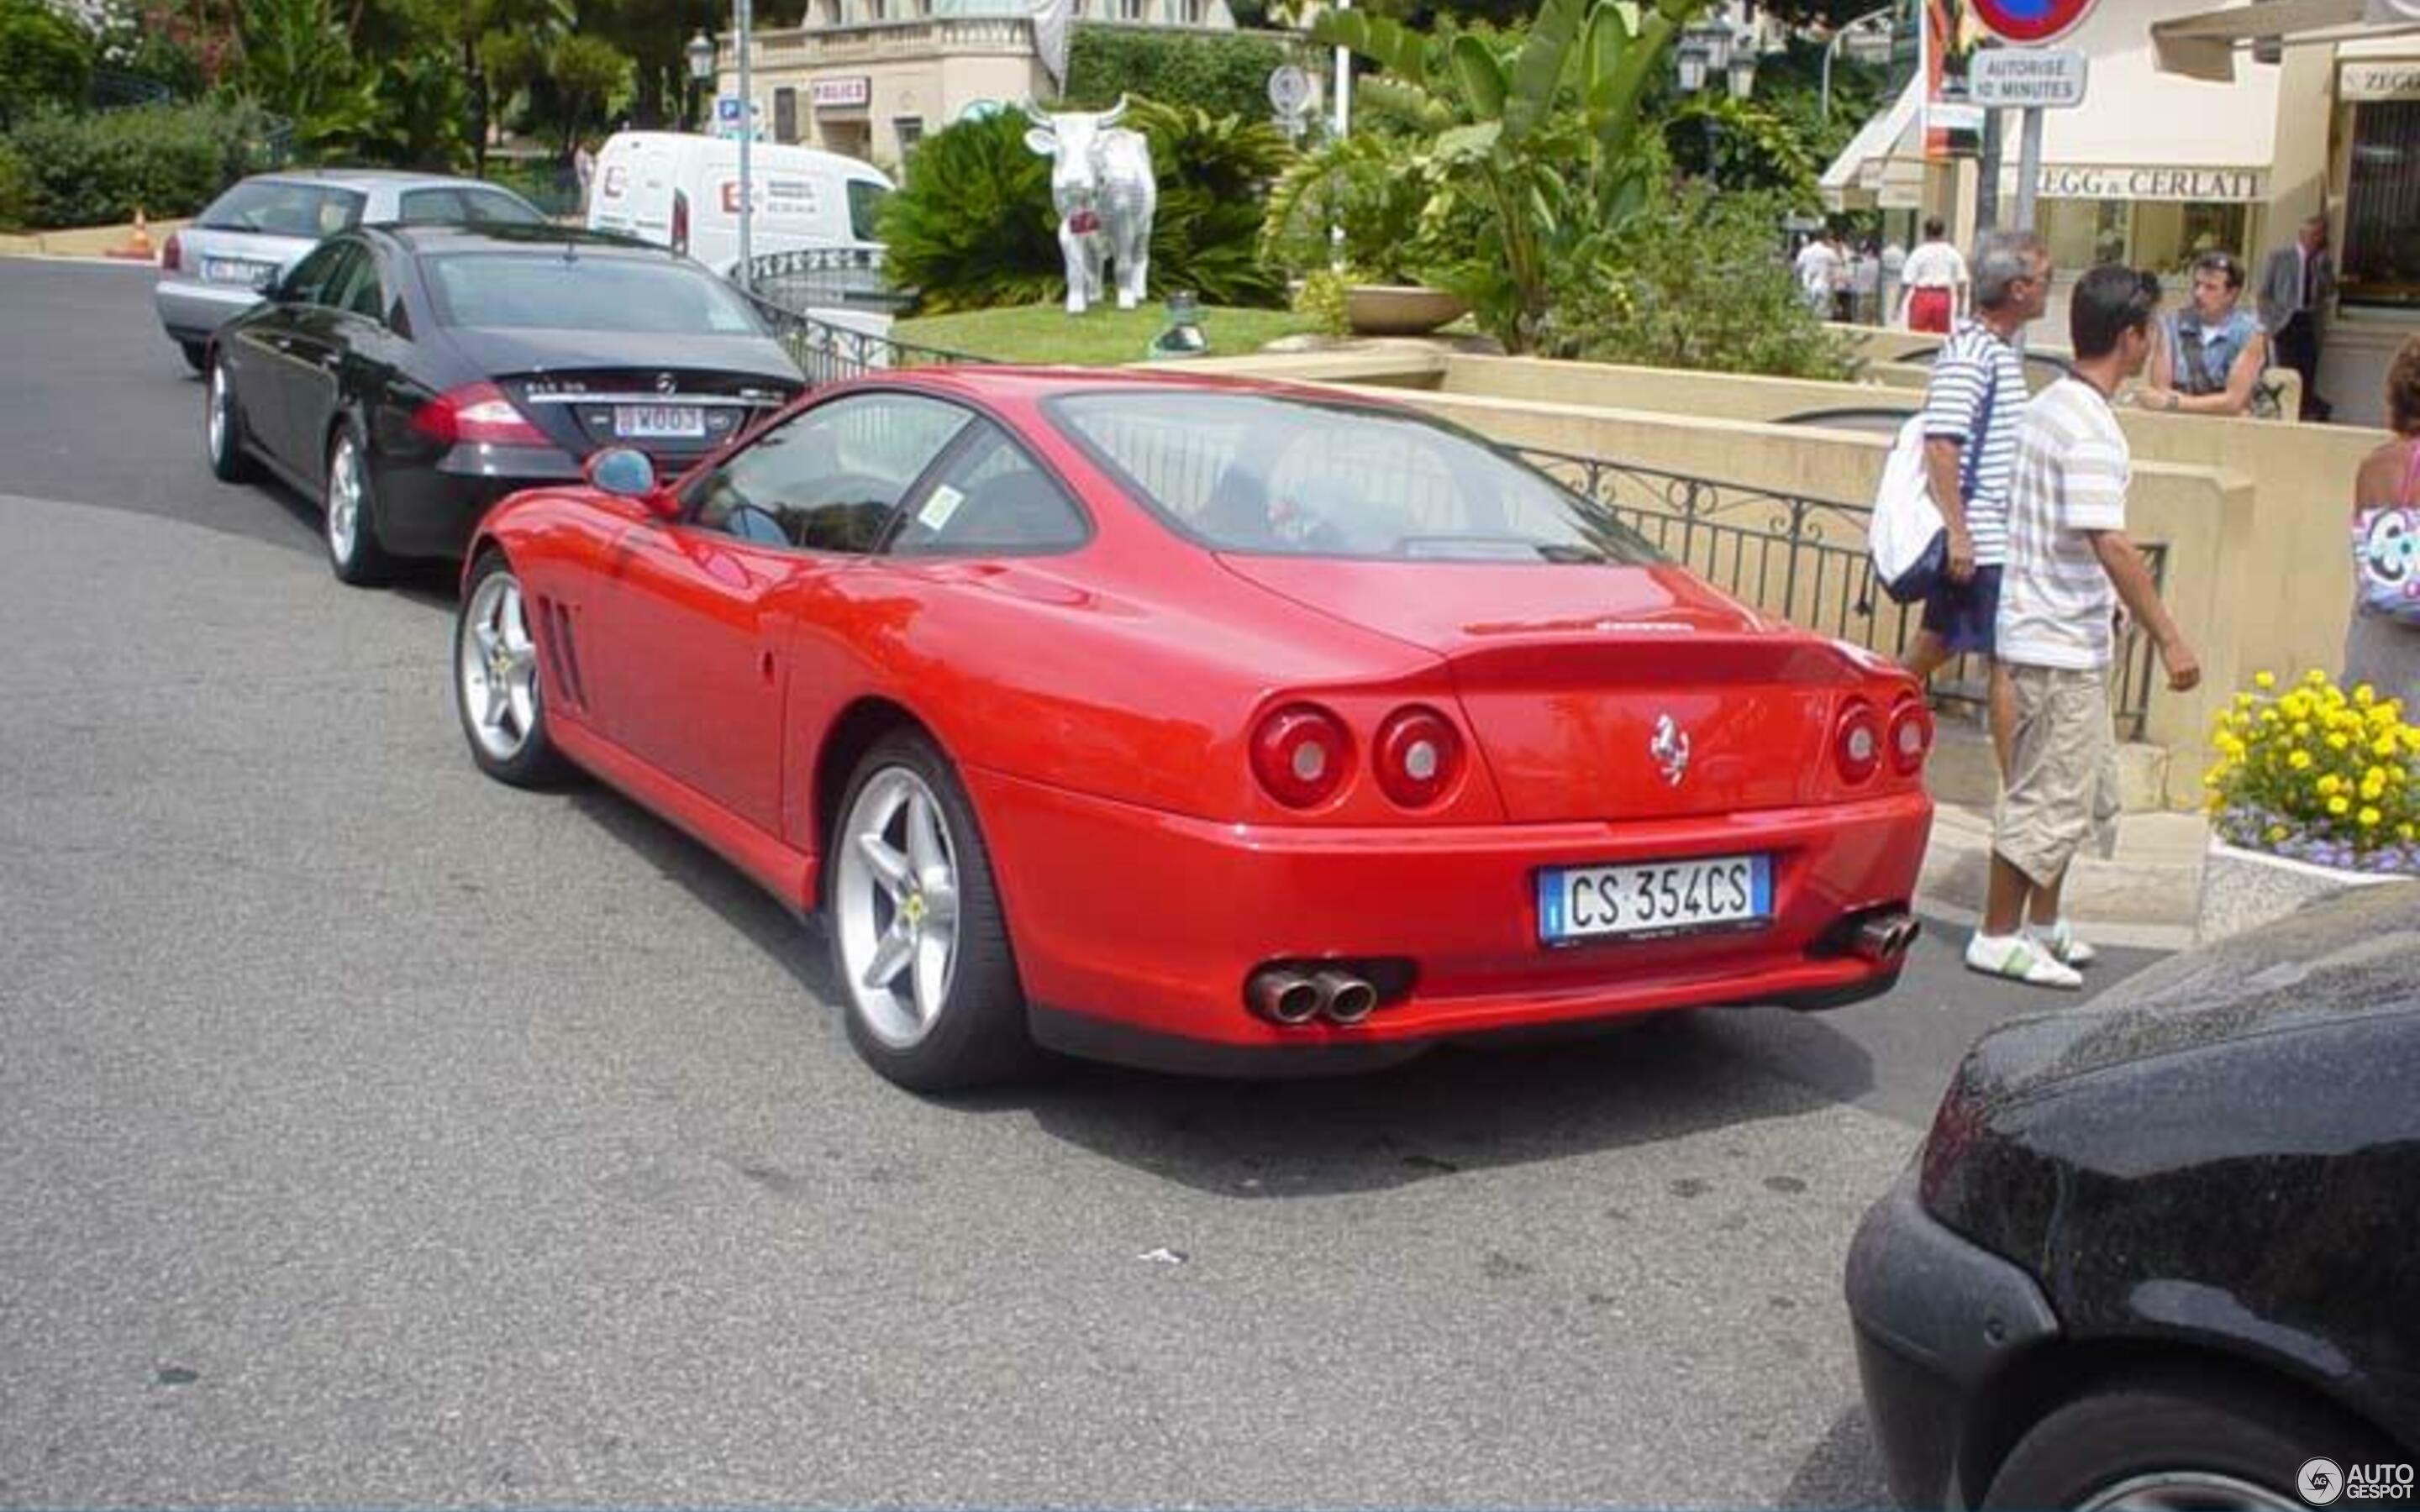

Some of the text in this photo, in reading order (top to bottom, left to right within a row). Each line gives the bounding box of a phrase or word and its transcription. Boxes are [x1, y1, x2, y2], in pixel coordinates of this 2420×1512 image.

[814, 83, 863, 100] POLICE
[2002, 81, 2073, 98] MINUTES
[2129, 170, 2259, 197] CERLATI
